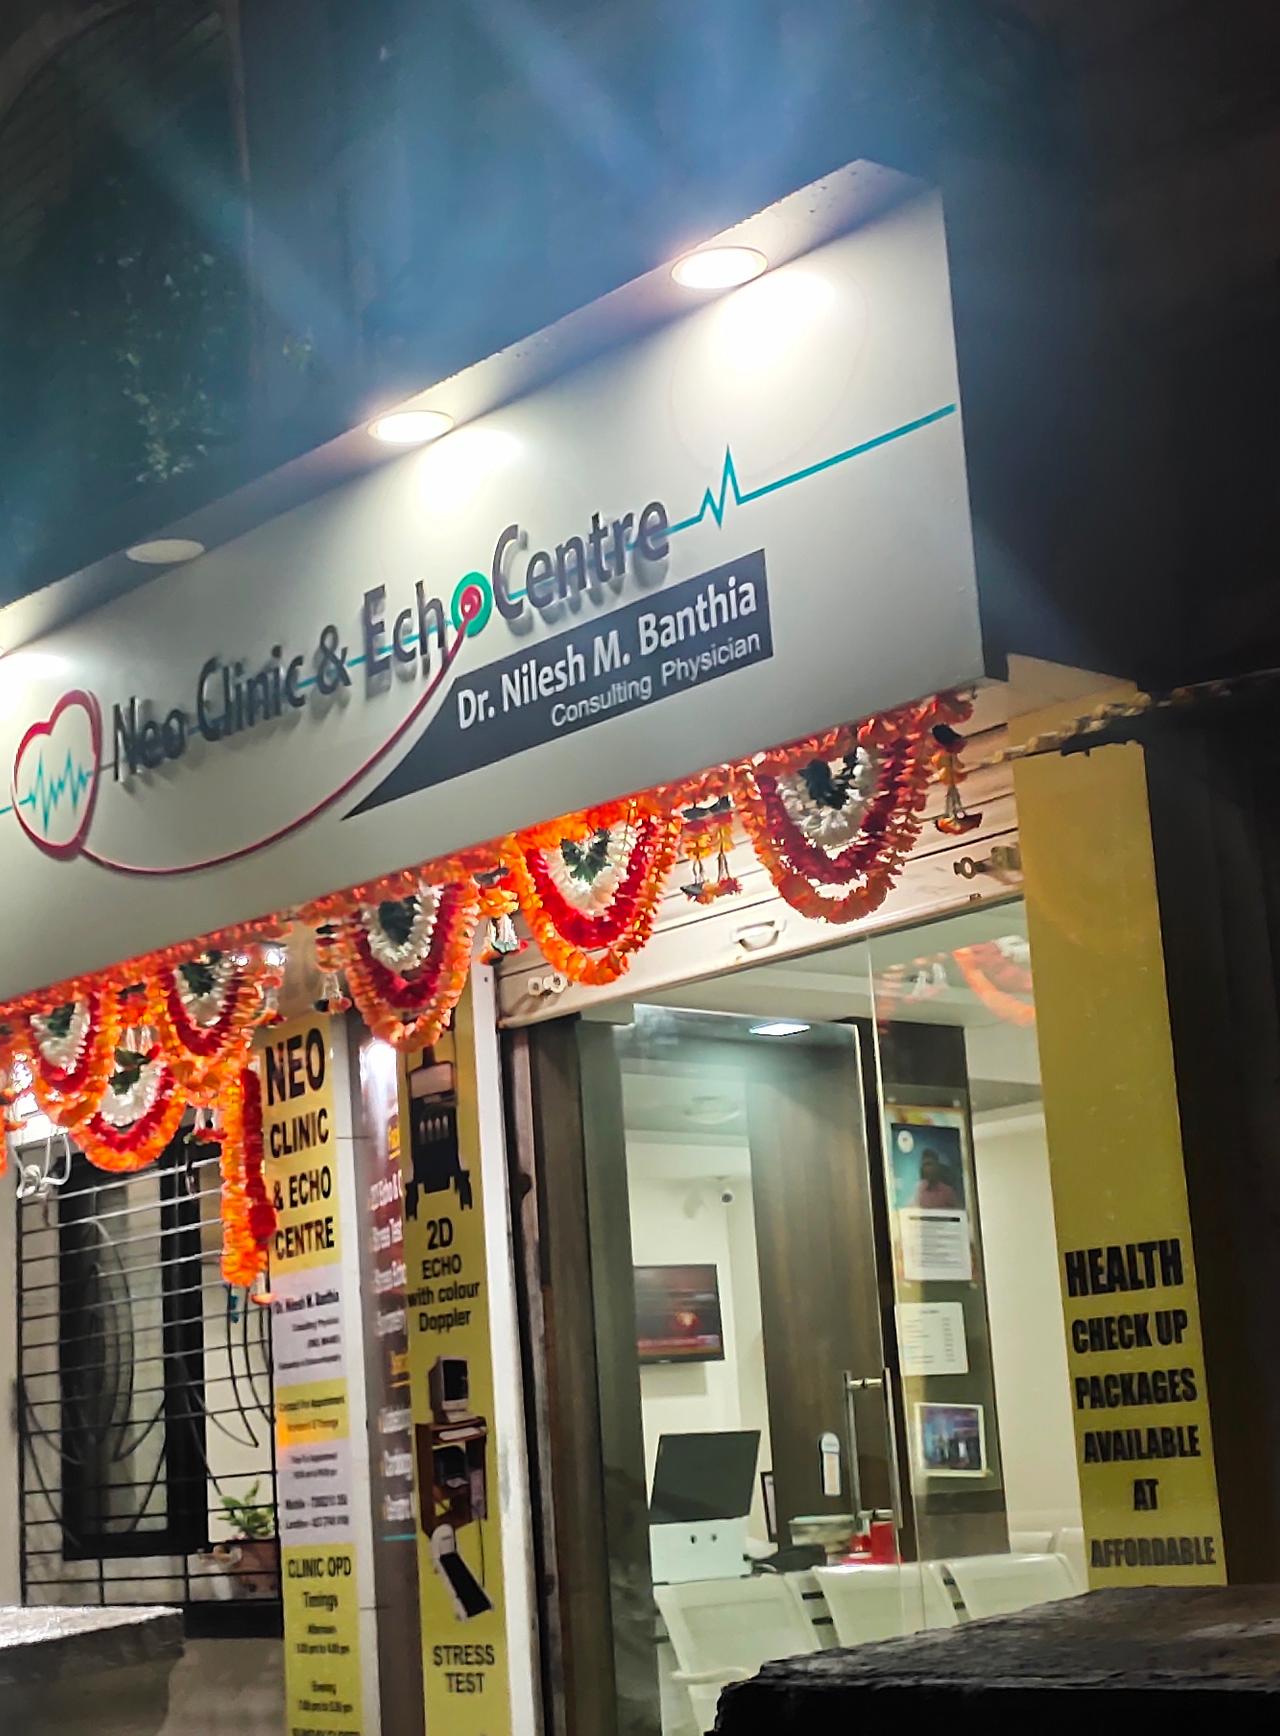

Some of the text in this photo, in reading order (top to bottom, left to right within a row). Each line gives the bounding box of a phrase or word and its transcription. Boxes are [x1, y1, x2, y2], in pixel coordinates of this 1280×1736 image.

[113, 501, 669, 782] Neo Clinic & Echo Centre
[457, 576, 757, 729] Dr. Nilesh M. Banthia
[551, 633, 760, 727] Consulting Physician
[265, 1027, 326, 1106] NEO
[269, 1107, 329, 1159] CLINIC
[273, 1181, 285, 1211] &
[289, 1165, 332, 1209] ECHO
[275, 1216, 335, 1260] CENTRE
[426, 1217, 454, 1251] 2D
[422, 1253, 463, 1281] ECHO
[1065, 1238, 1184, 1298] HEALTH
[407, 1280, 480, 1307] with colour
[419, 1308, 472, 1337] Doppler
[1071, 1308, 1189, 1354] CHECK UP
[1074, 1367, 1198, 1410] PACKAGES
[1083, 1425, 1201, 1464] AVAILABLE
[1133, 1478, 1159, 1511] AT
[288, 1556, 352, 1579] CLINIC OPD
[1091, 1535, 1217, 1568] AFFORDABLE
[431, 1643, 496, 1668] STRESS
[443, 1671, 486, 1695] TEST
